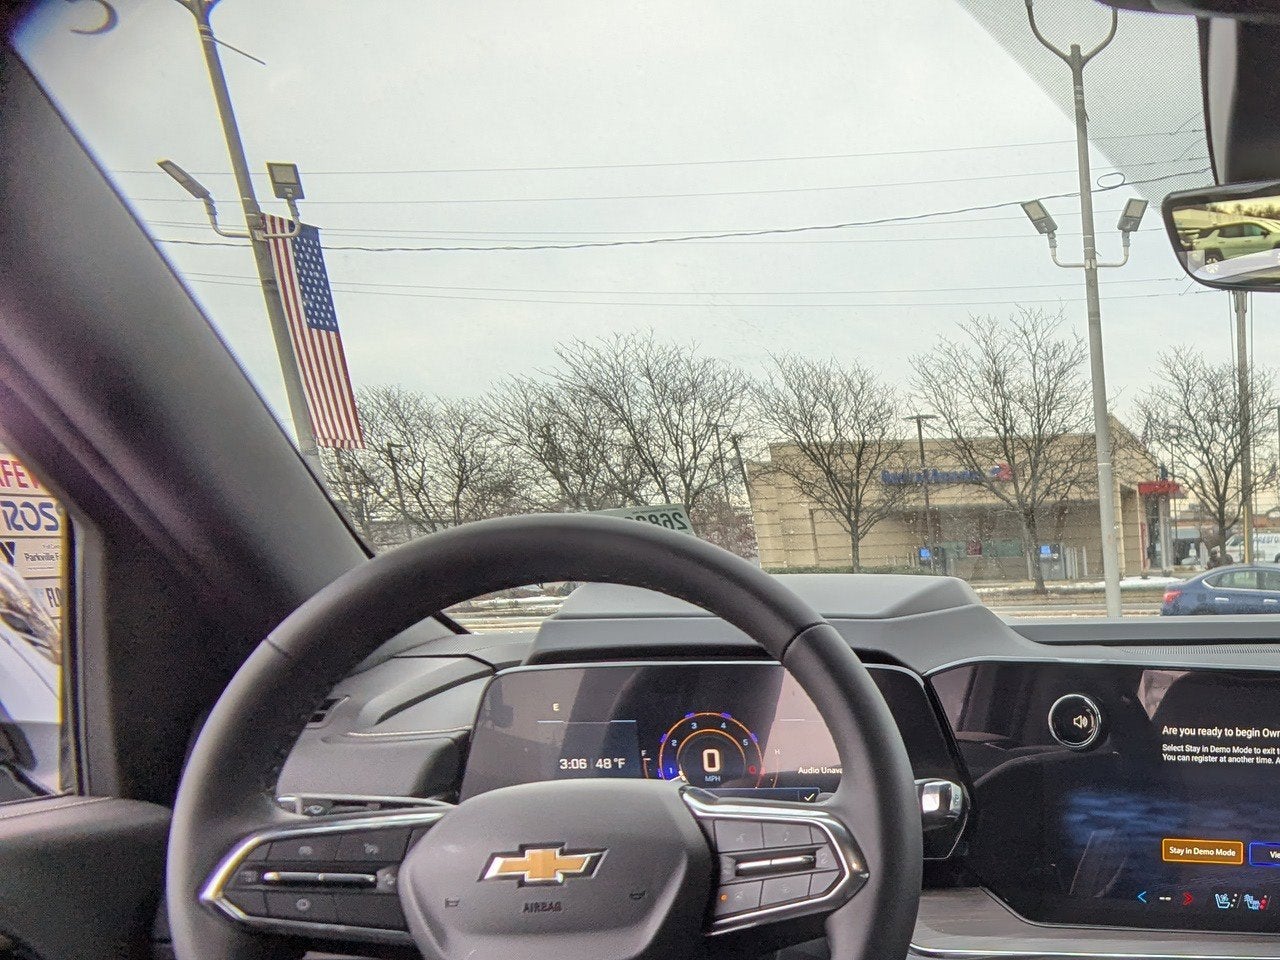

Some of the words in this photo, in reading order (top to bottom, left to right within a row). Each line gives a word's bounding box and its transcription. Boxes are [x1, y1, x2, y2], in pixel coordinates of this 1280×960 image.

[24, 552, 54, 562] Parkville
[552, 703, 560, 711] E
[1161, 725, 1178, 735] Are
[1179, 727, 1196, 738] you
[1197, 726, 1223, 739] ready
[1224, 728, 1234, 737] to
[1235, 727, 1260, 739] begin
[1162, 743, 1184, 752] Select
[1184, 744, 1200, 753] Stay
[1201, 745, 1209, 753] in
[1210, 745, 1231, 753] Demo
[1232, 746, 1252, 754] Mode
[1262, 747, 1276, 755] exit
[559, 758, 587, 770] 3:06
[703, 748, 720, 772] 0
[1162, 753, 1176, 761] You
[1191, 754, 1218, 763] register
[1219, 755, 1227, 763] at
[1228, 755, 1255, 764] another
[1255, 756, 1274, 764] time.
[704, 775, 721, 783] MPH
[1169, 846, 1185, 856] Stay
[1185, 847, 1193, 855] in
[1193, 847, 1214, 855] Demo
[1215, 848, 1236, 857] Mode
[523, 901, 562, 913] AIRBAG
